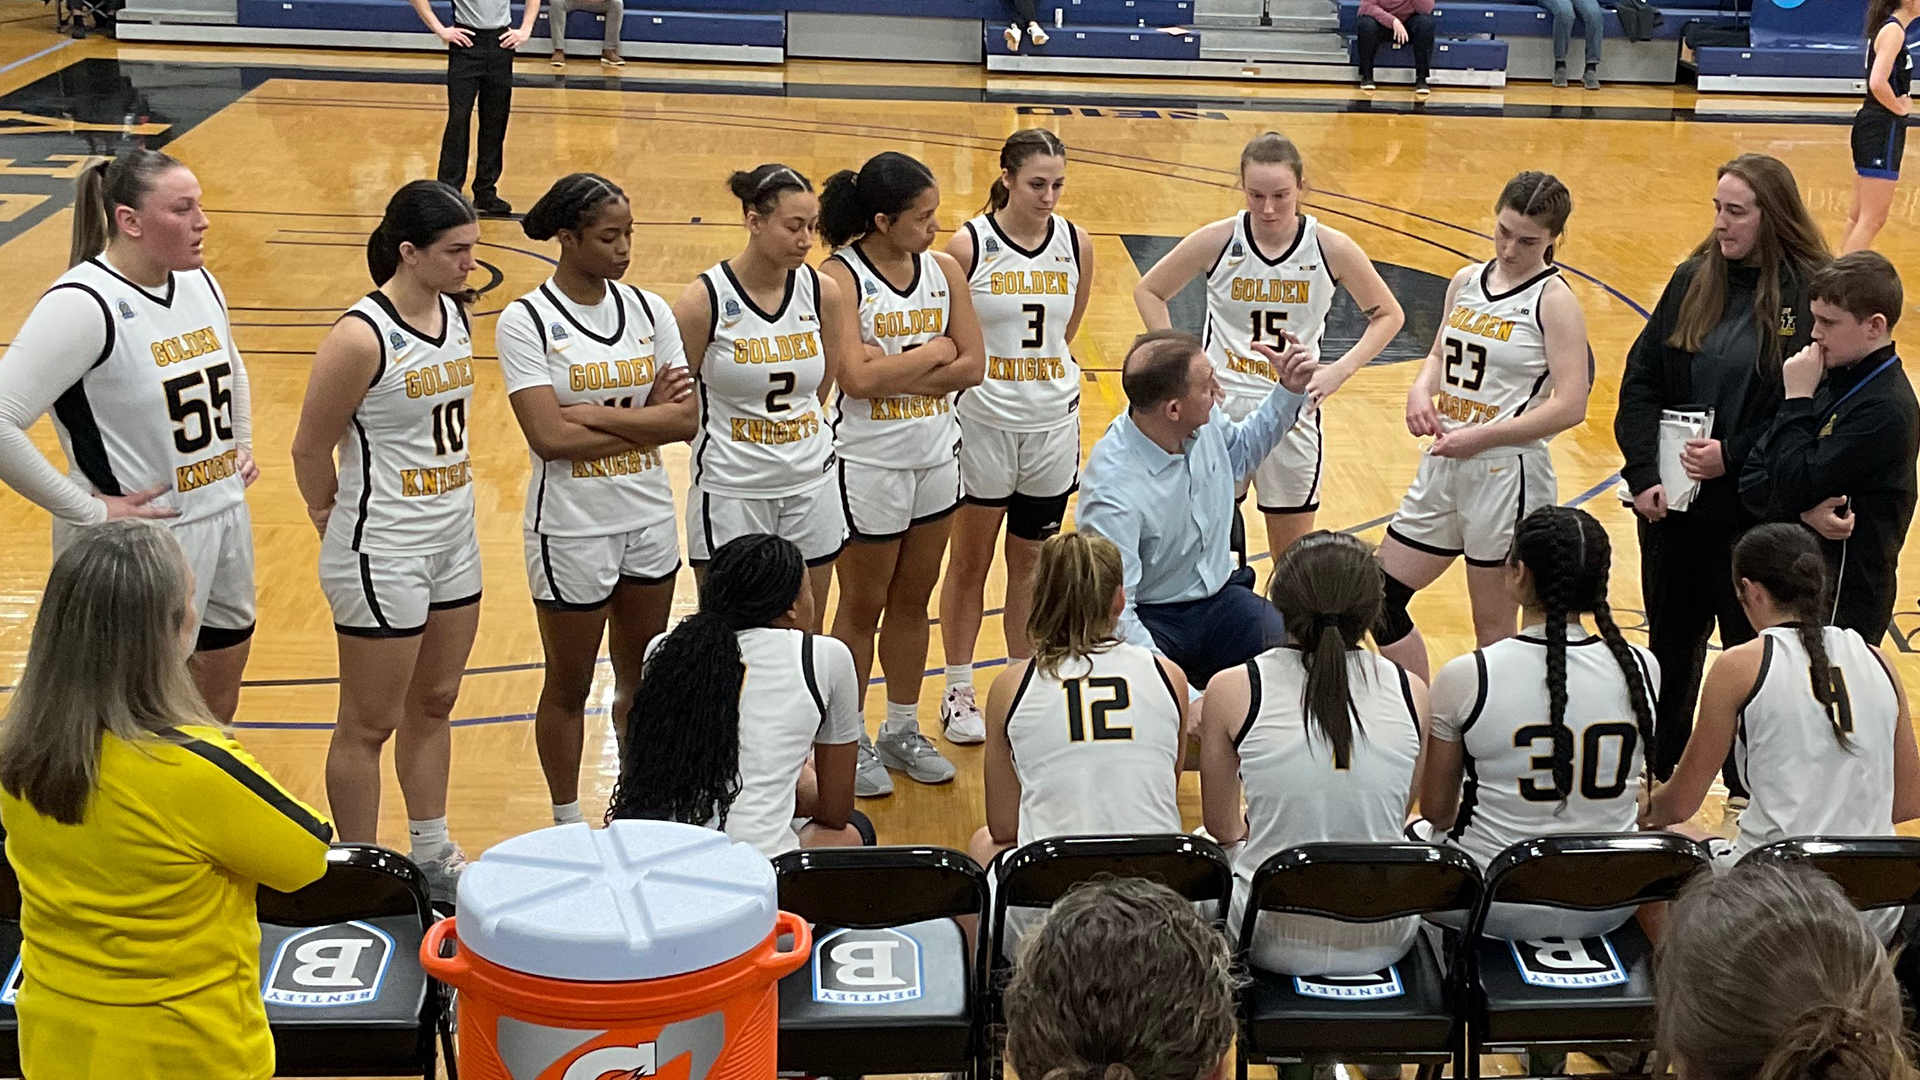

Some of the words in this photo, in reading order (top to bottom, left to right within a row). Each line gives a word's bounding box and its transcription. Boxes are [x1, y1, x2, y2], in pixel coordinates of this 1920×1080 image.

[990, 271, 1069, 295] GOLDEN
[1231, 277, 1310, 304] GOLDEN
[873, 308, 943, 338] GOLDEN
[1021, 303, 1045, 348] 3
[1250, 310, 1288, 352] 15
[151, 326, 222, 367] GOLDEN
[733, 331, 818, 364] GOLDEN
[1445, 336, 1487, 391] 23
[988, 356, 1065, 381] KNIGHTS
[162, 362, 234, 454] 55
[765, 371, 796, 414] 2
[431, 398, 466, 457] 10
[730, 411, 820, 445] KNIGHTS
[1061, 676, 1134, 743] 12
[1512, 721, 1639, 802] 30
[292, 938, 373, 986] B
[830, 940, 907, 985] B
[1531, 972, 1621, 984] BENTLEY
[268, 991, 372, 1003] BENTLEY
[821, 989, 918, 1001] BENTLEY
[1304, 984, 1396, 996] BENTLEY
